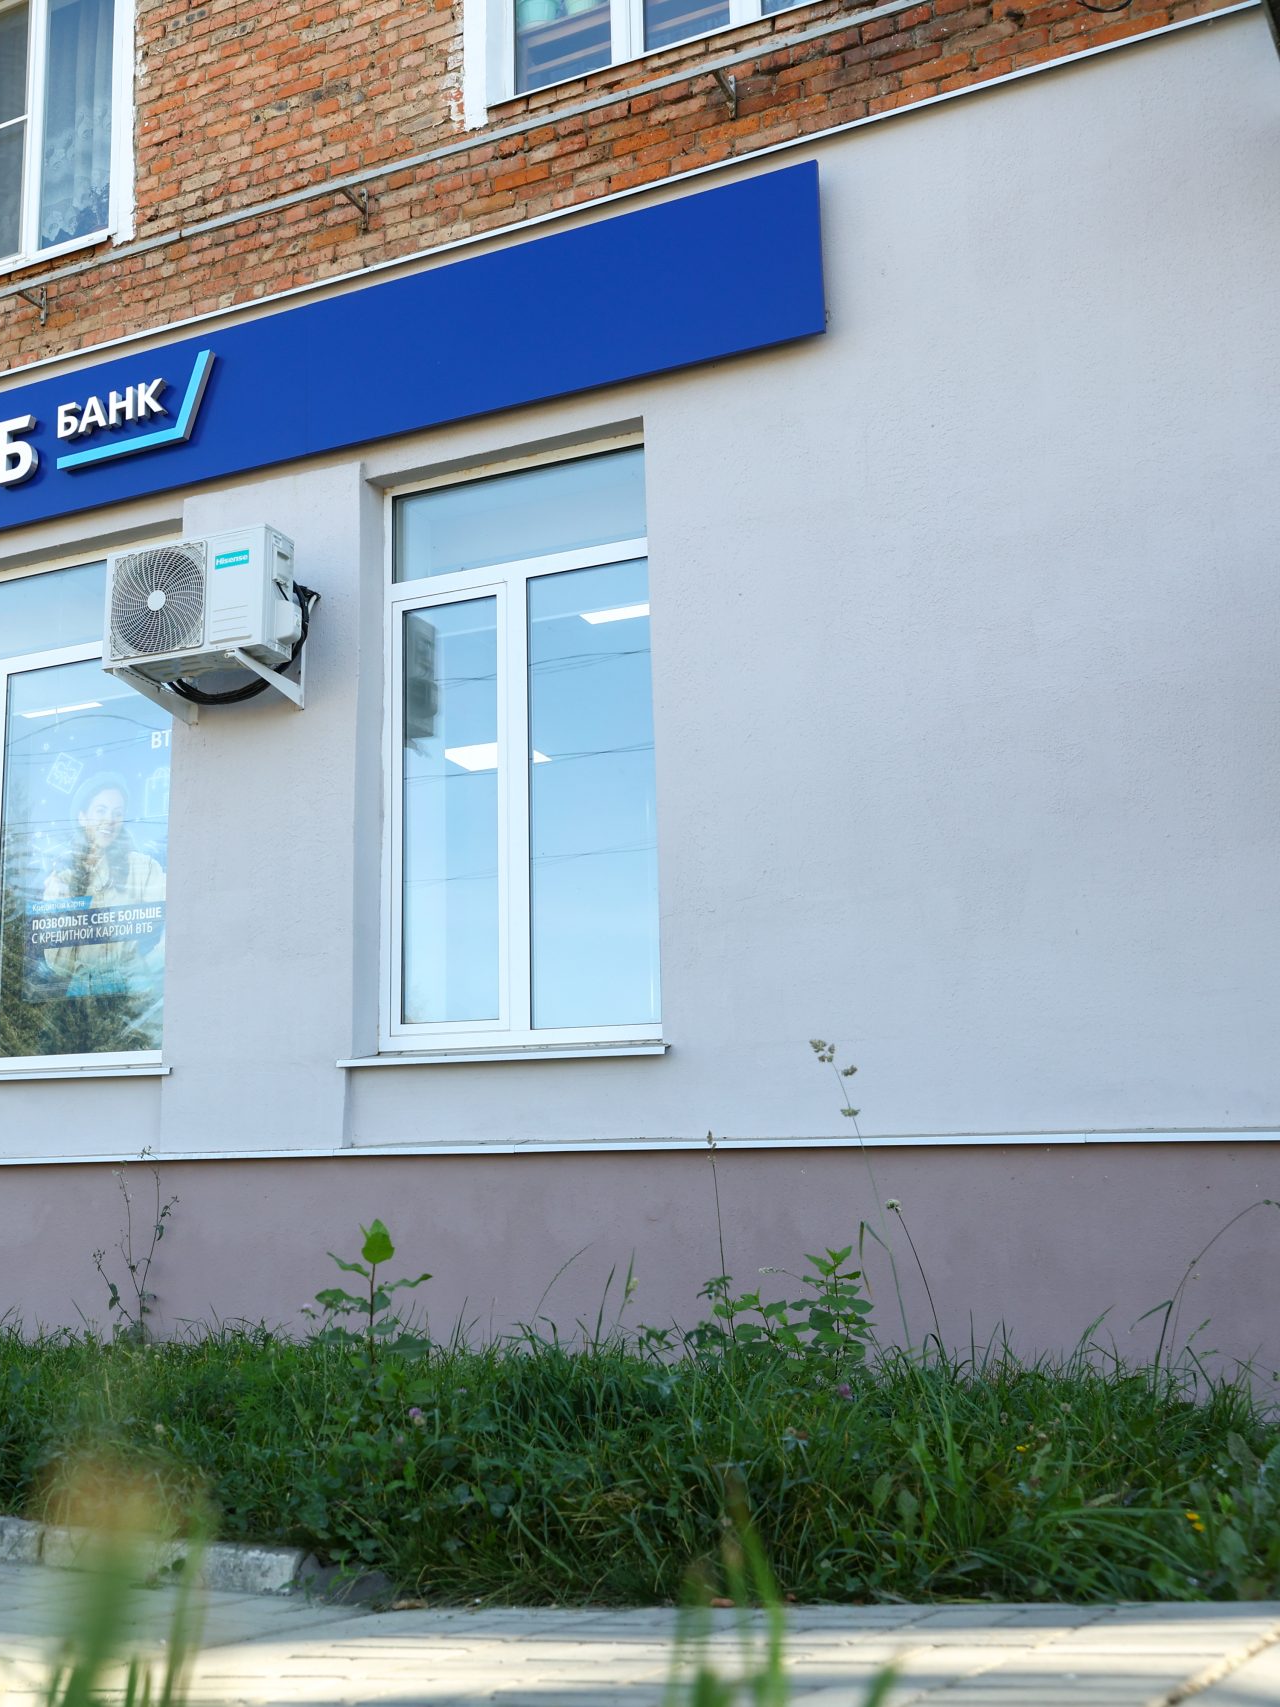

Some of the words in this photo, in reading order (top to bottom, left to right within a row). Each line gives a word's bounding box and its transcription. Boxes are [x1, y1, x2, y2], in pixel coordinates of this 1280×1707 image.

[57, 377, 169, 439] БАНК
[215, 552, 249, 567] Hisense
[32, 914, 89, 931] ПОЗВОЛЬТЕ
[90, 911, 115, 925] СЕБЕ
[118, 906, 162, 922] БОЛЬШЕ
[31, 932, 38, 944] С
[39, 926, 94, 944] КРЕДИТНОЙ
[96, 921, 133, 938] КАРТОЙ
[135, 921, 153, 934] ВТБ
